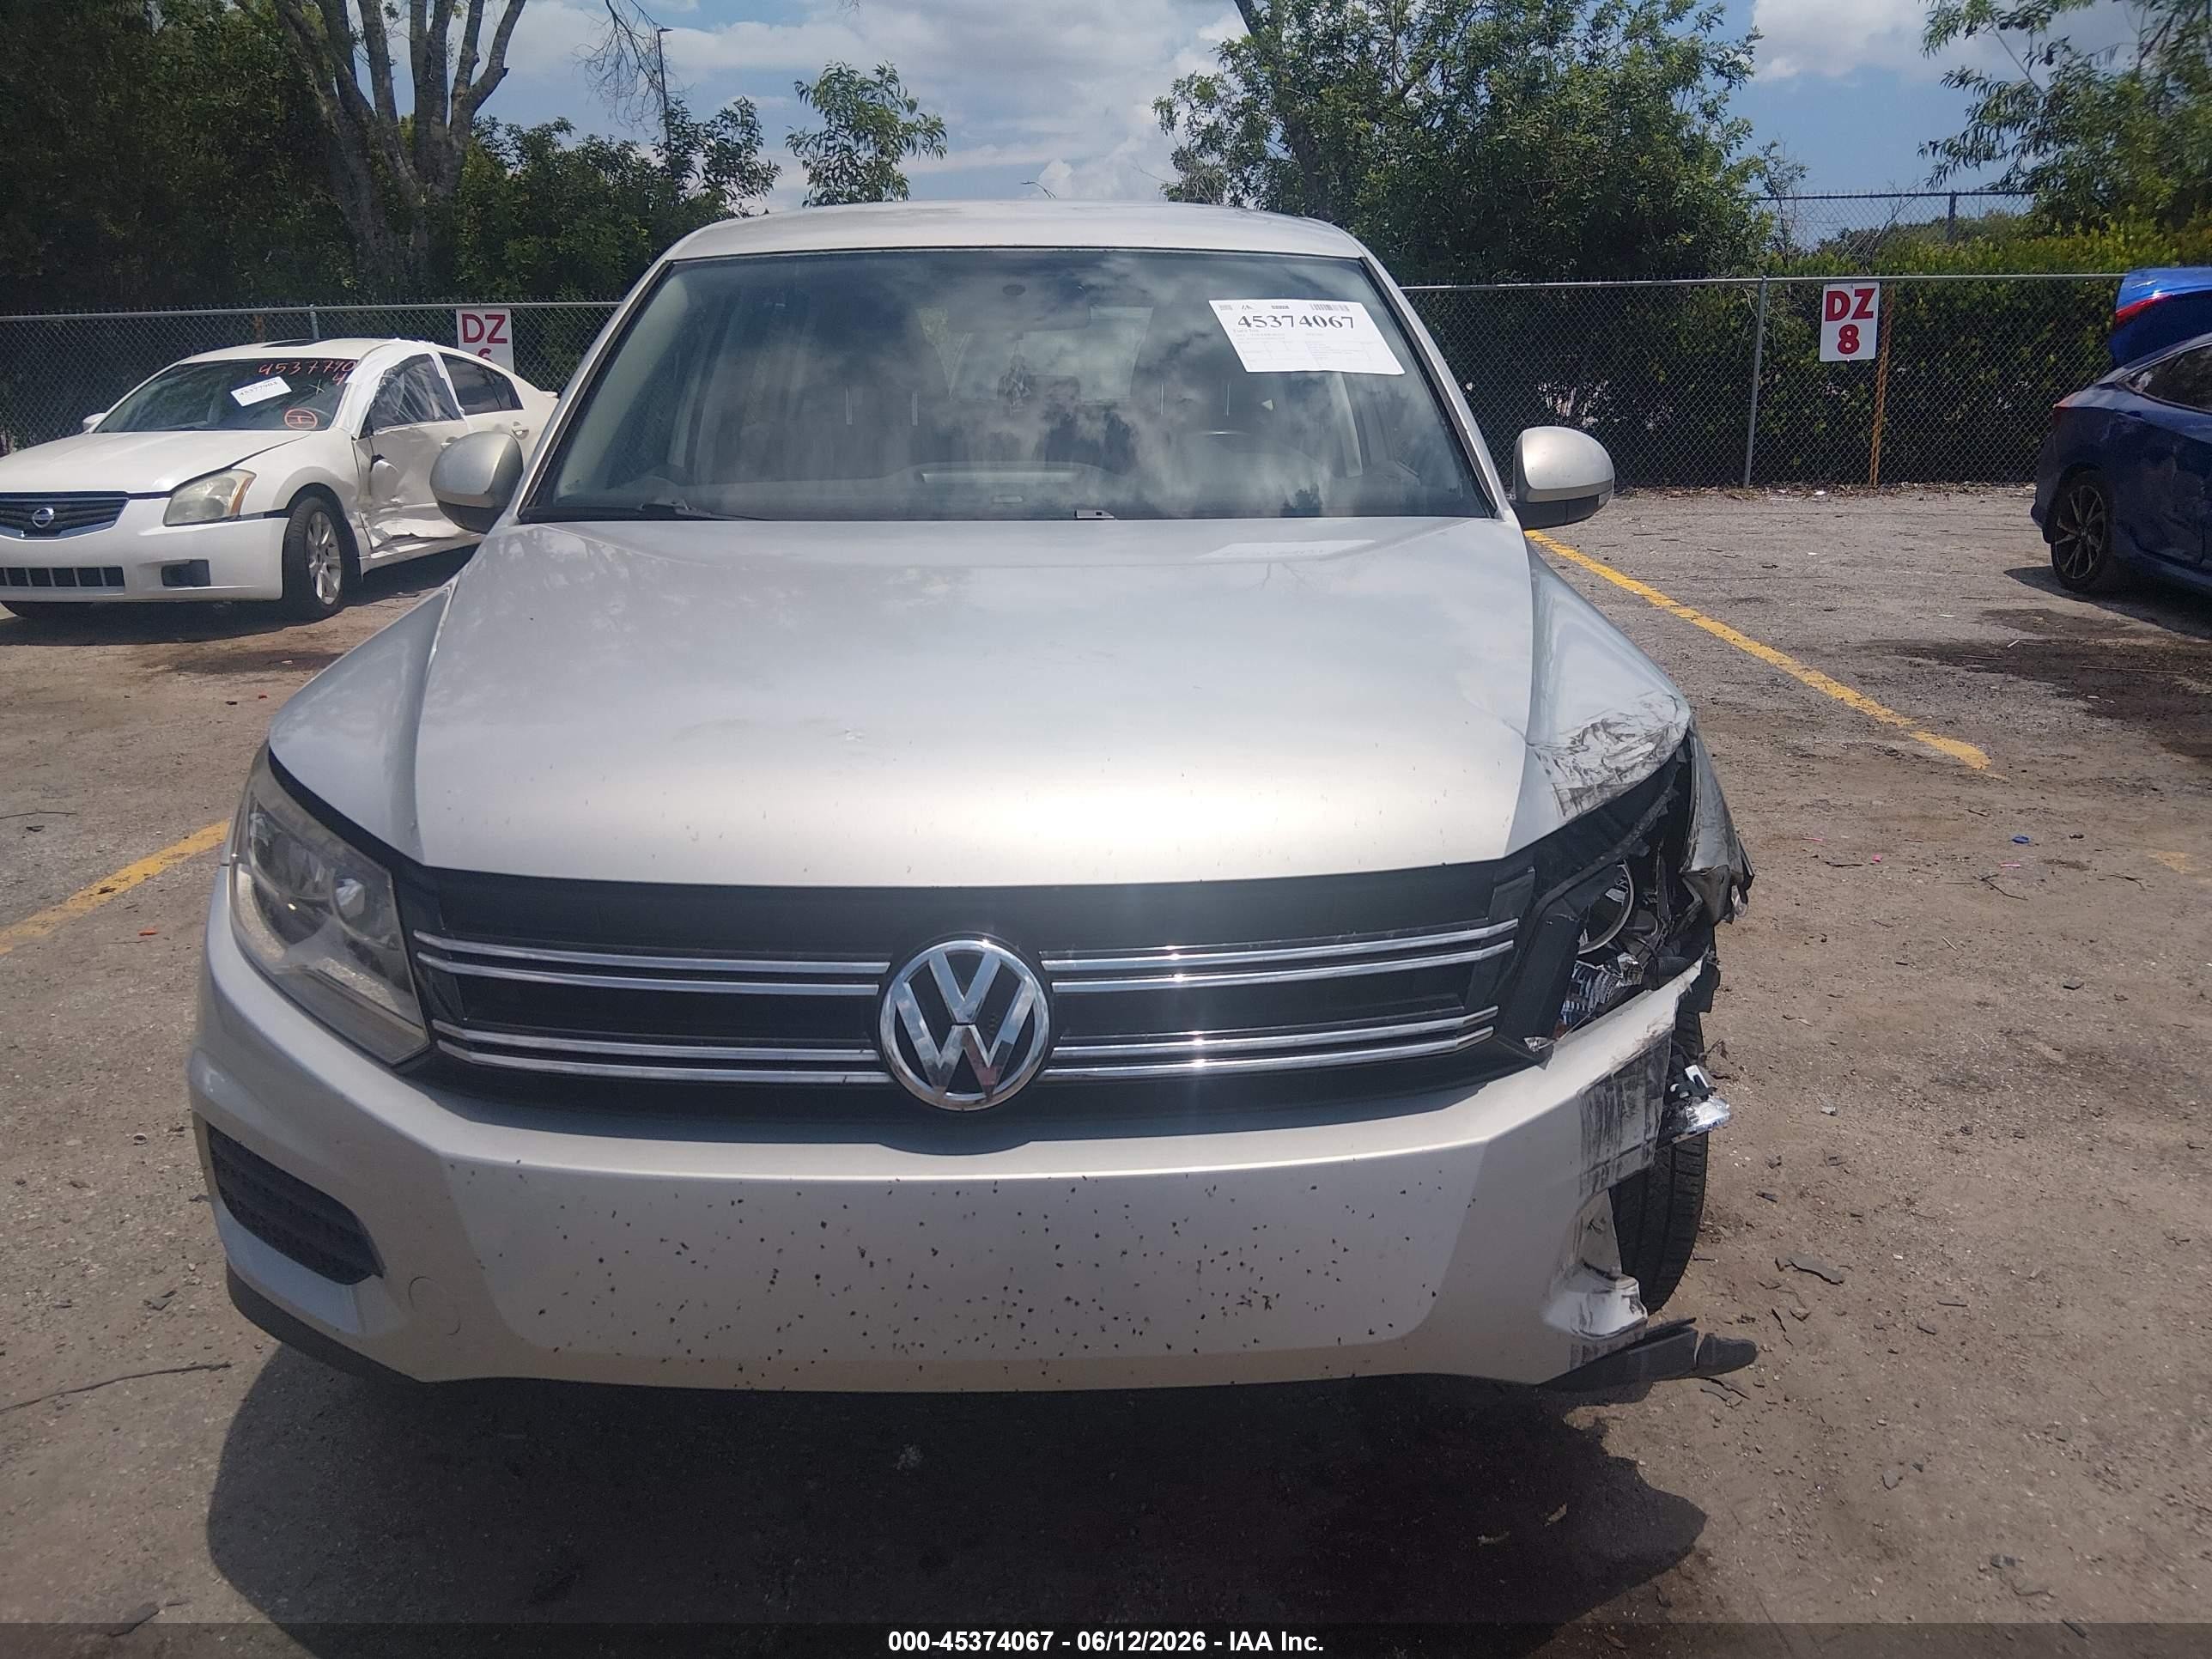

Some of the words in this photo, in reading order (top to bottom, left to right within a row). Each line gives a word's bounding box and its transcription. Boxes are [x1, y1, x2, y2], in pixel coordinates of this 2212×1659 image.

[1825, 288, 1876, 322] DZ
[461, 313, 507, 344] DZ
[1237, 314, 1355, 330] 45374067
[1837, 324, 1860, 355] 8
[890, 943, 1036, 1099] VW
